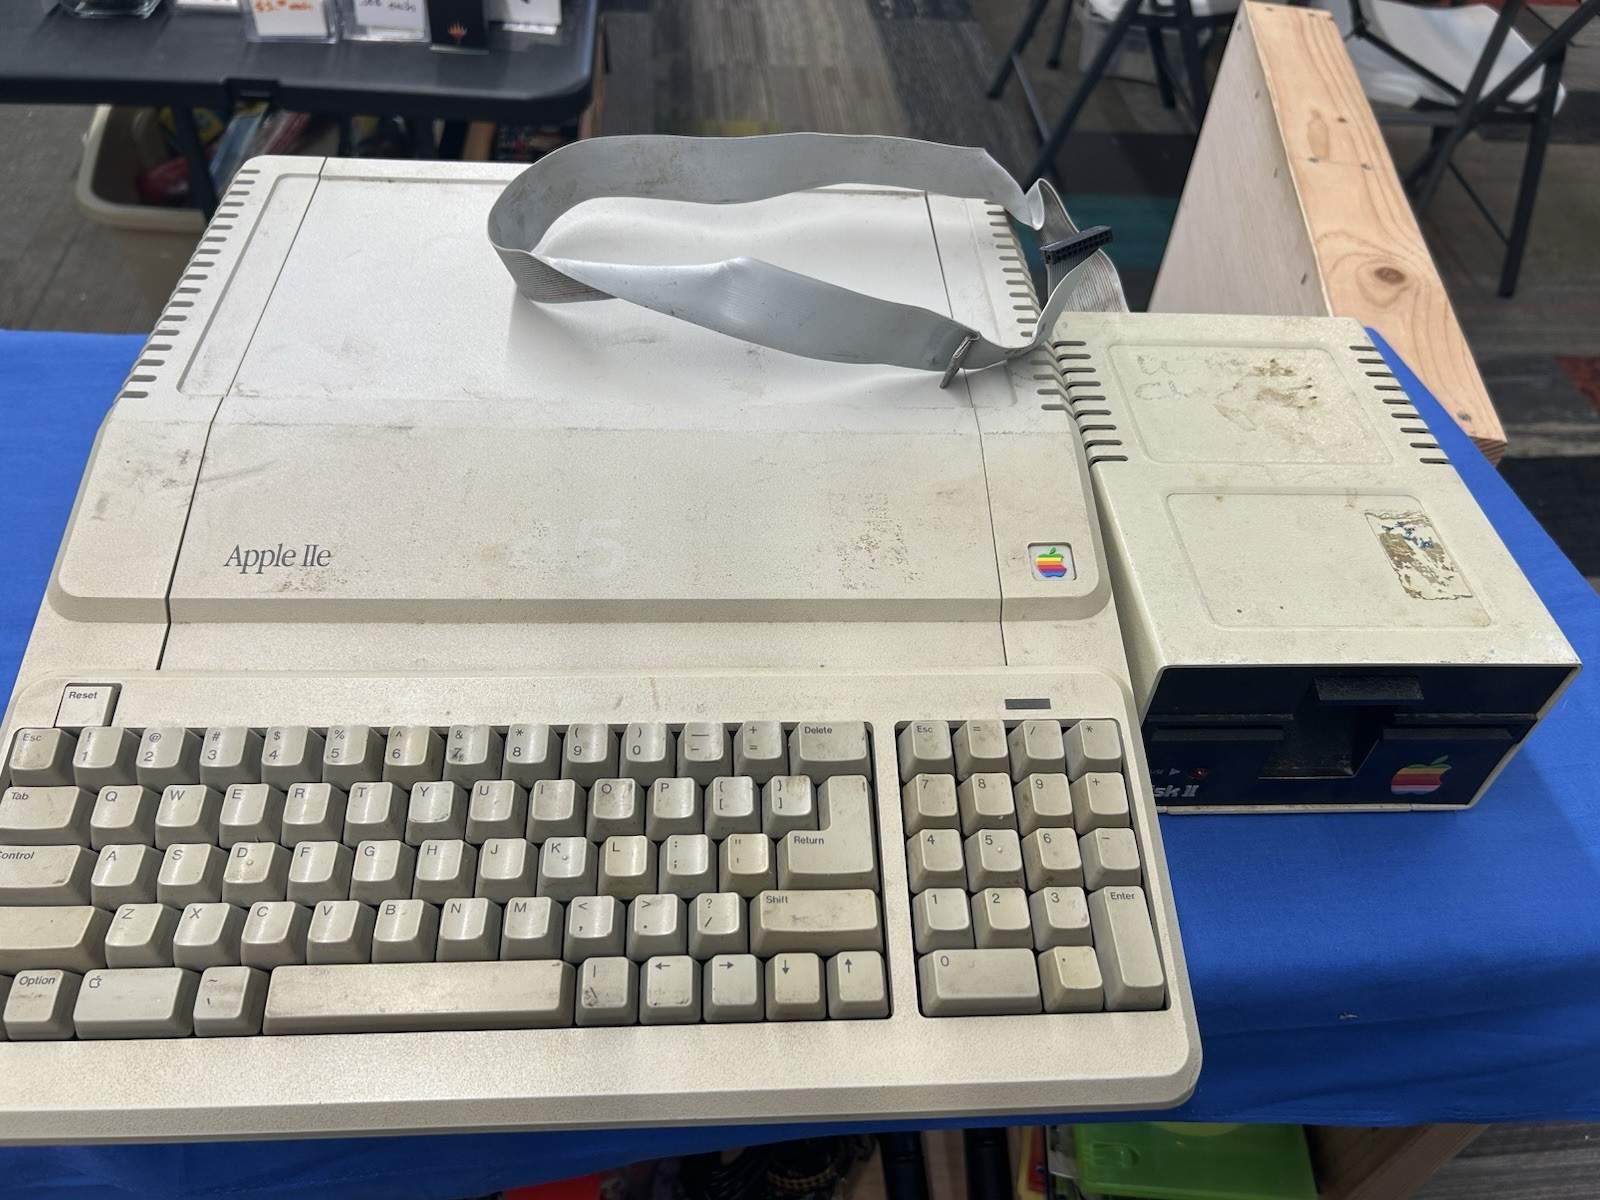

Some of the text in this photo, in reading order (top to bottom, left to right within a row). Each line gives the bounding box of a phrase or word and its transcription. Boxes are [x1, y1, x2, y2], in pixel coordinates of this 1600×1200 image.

[223, 543, 332, 575] Apple IIe
[68, 691, 98, 700] Reset
[804, 725, 833, 735] Delete
[916, 725, 934, 734] Esc
[21, 732, 42, 742] Esc
[143, 750, 155, 762] 2
[206, 749, 218, 761] 3
[268, 749, 279, 761] 4
[330, 747, 340, 759] 5
[391, 748, 401, 760] 6
[452, 748, 464, 760] 7
[512, 746, 522, 758] 8
[573, 745, 583, 757] 9
[632, 744, 642, 756] 0
[80, 750, 89, 763] 1
[600, 782, 613, 795] O
[660, 782, 670, 793] P
[921, 778, 930, 790] 7
[977, 777, 987, 790] 8
[1034, 778, 1044, 790] 9
[11, 791, 29, 801] Tab
[104, 790, 118, 803] Q
[169, 789, 186, 801] W
[231, 788, 243, 800] E
[293, 787, 306, 799] R
[356, 786, 368, 798] T
[419, 786, 430, 797] Y
[478, 785, 490, 797] U
[793, 835, 825, 845] Return
[926, 834, 935, 845] 4
[984, 834, 994, 846] 5
[1042, 832, 1052, 844] 6
[236, 846, 248, 859] D
[299, 846, 311, 858] F
[363, 845, 375, 857] G
[426, 844, 438, 856] H
[489, 843, 499, 855] J
[550, 842, 562, 854] K
[612, 841, 621, 853] L
[105, 850, 117, 861] A
[171, 850, 184, 861] S
[765, 895, 789, 904] Shift
[991, 892, 1001, 904] 2
[1050, 891, 1060, 904] 3
[1109, 891, 1135, 901] Enter
[256, 905, 269, 918] C
[322, 905, 334, 917] V
[384, 904, 397, 916] B
[450, 902, 462, 914] N
[513, 901, 527, 913] M
[120, 907, 136, 920] Z
[188, 907, 203, 920] X
[940, 955, 950, 967] 0
[18, 975, 56, 987] Option
